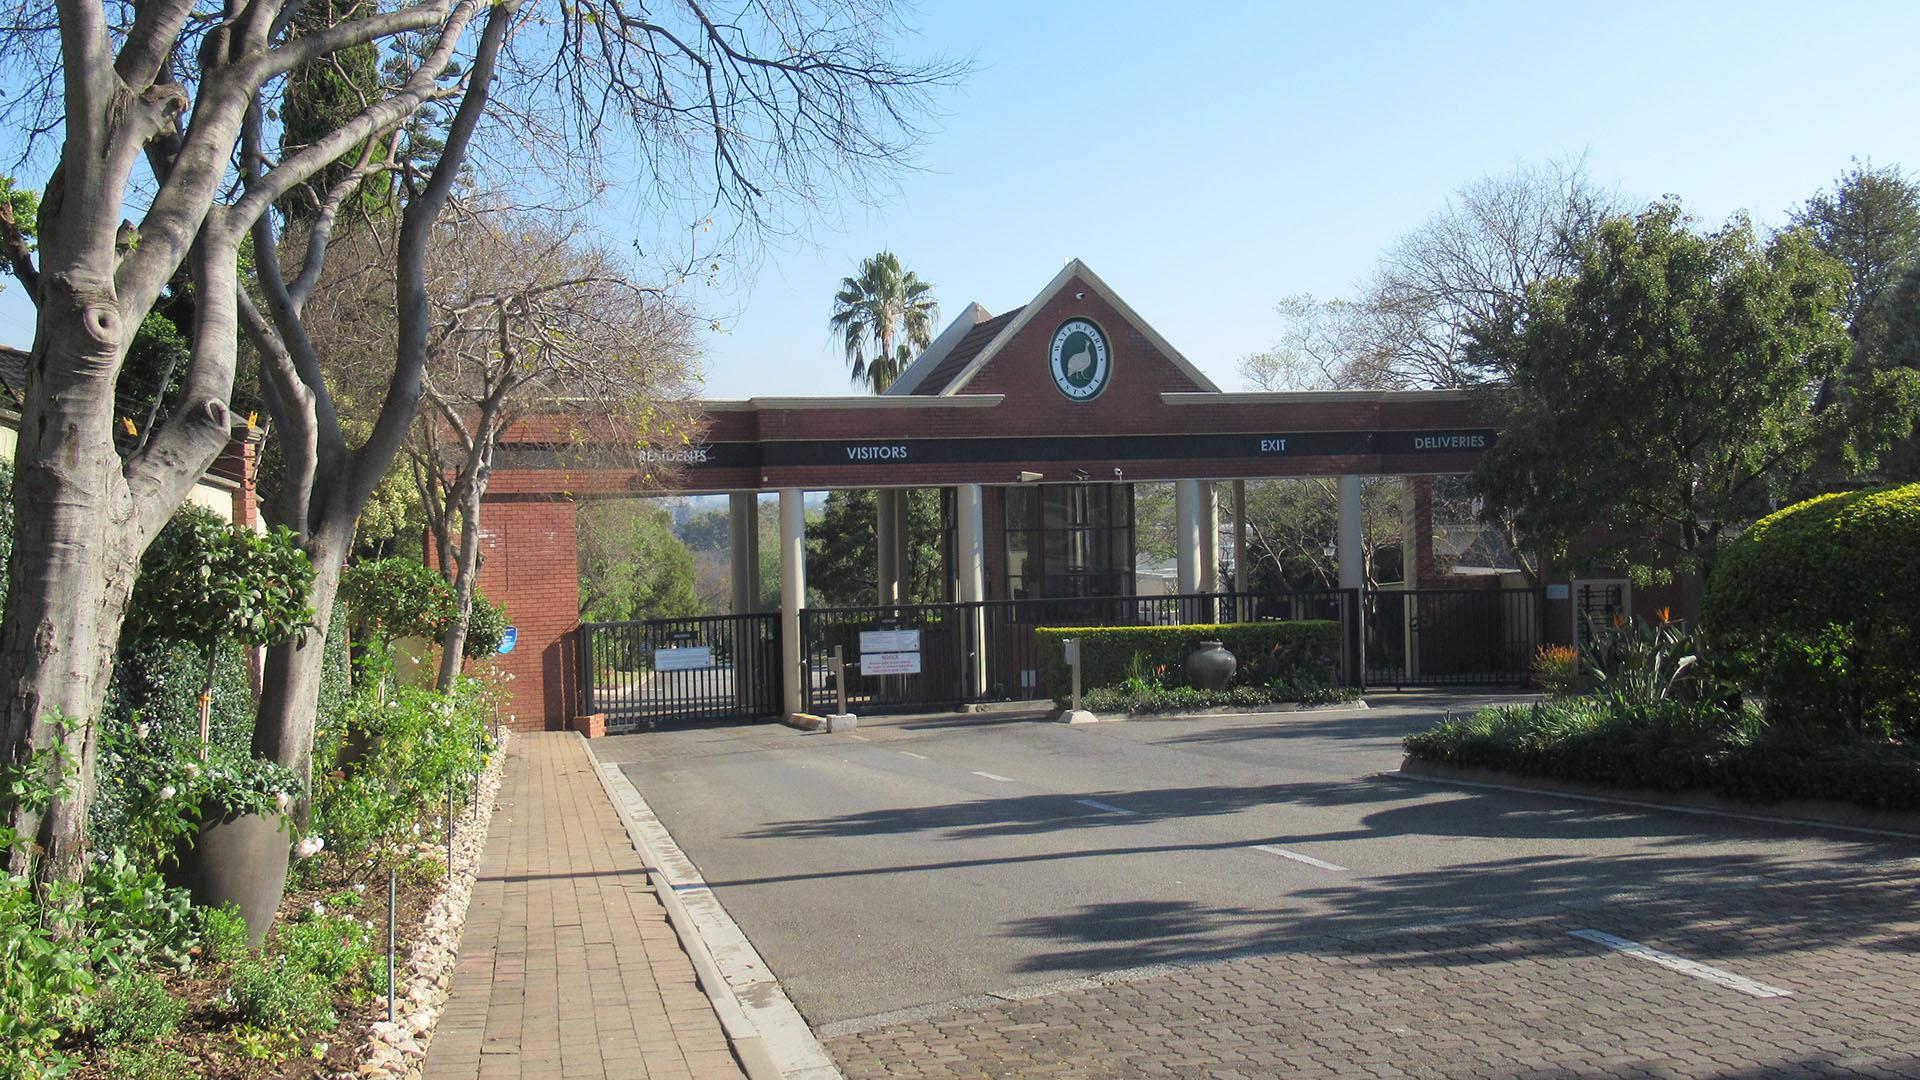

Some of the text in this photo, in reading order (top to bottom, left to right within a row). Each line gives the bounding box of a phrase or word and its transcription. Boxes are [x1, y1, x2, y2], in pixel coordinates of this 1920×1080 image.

[1054, 323, 1103, 352] WATERFORD
[1261, 439, 1286, 451] EXIT
[1414, 435, 1486, 449] DELIVERIES
[847, 446, 907, 459] VISITORS
